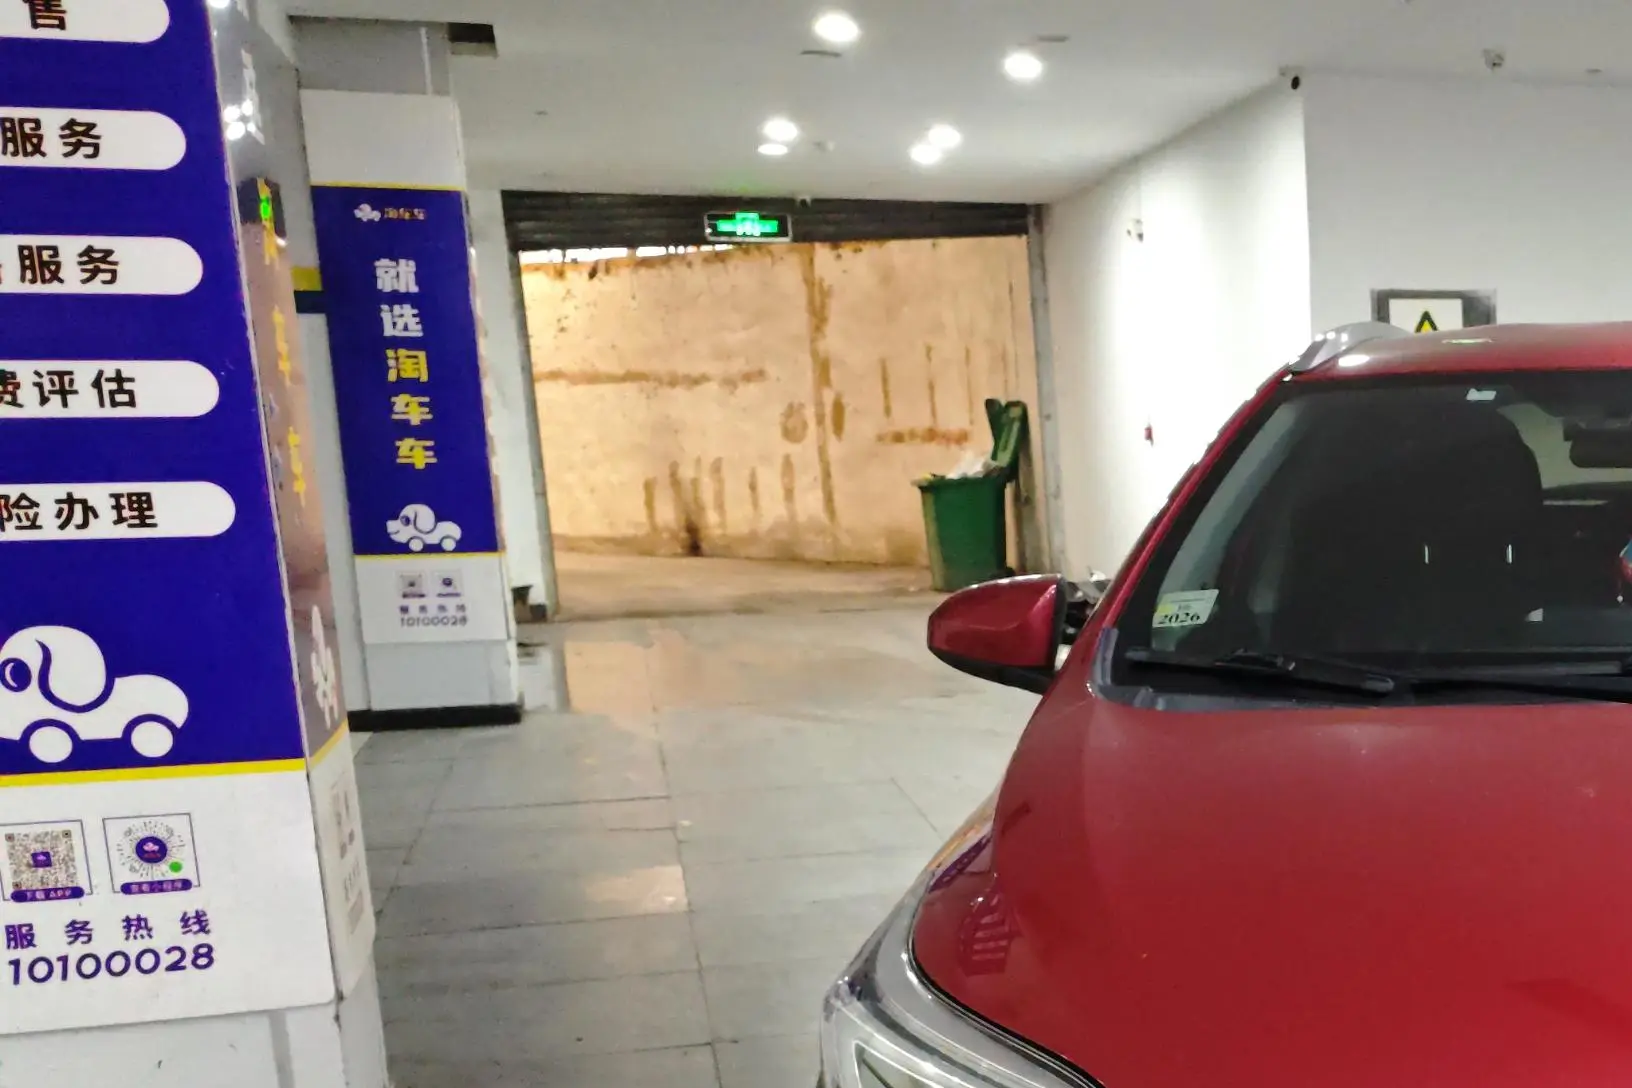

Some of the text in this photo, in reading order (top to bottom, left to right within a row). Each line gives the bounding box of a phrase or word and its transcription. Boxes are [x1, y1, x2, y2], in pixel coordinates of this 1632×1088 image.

[22, 0, 66, 30] 售
[0, 117, 102, 158] 服务
[0, 245, 119, 285] 服务
[374, 258, 437, 470] 就选淘车车
[0, 492, 158, 532] 险办理
[4, 909, 211, 950] 服务热线
[8, 943, 215, 985] 10100028
